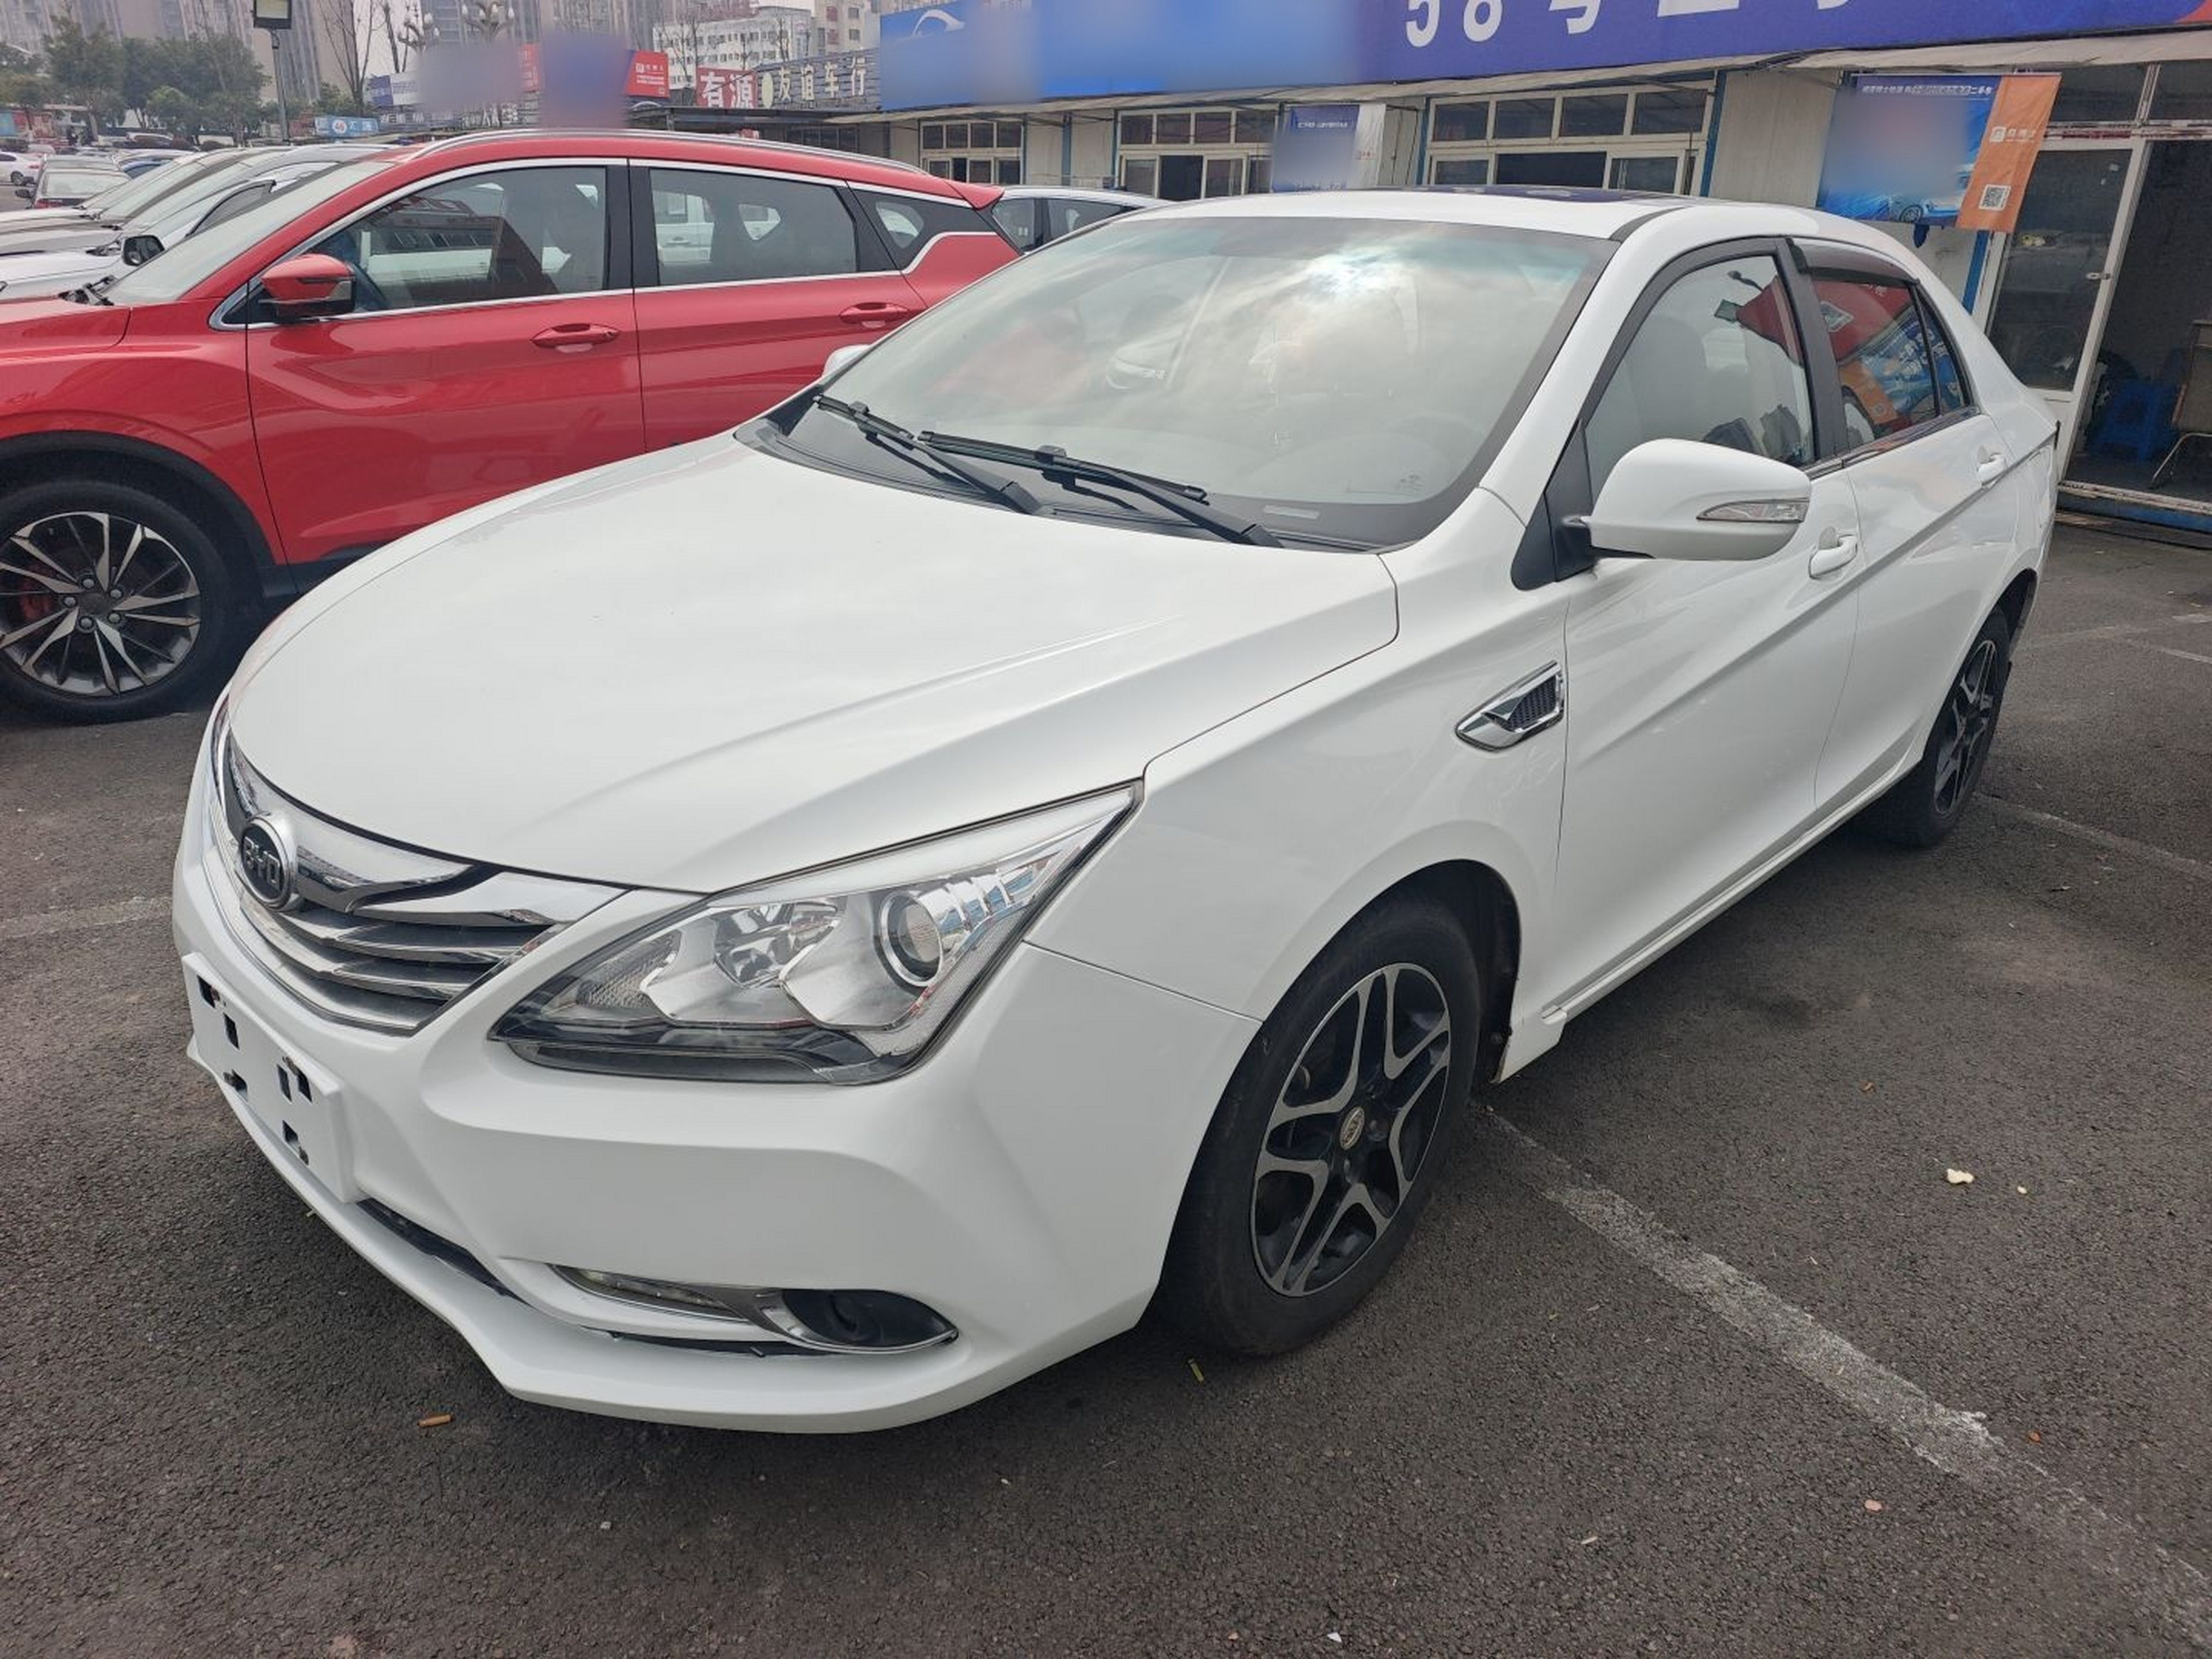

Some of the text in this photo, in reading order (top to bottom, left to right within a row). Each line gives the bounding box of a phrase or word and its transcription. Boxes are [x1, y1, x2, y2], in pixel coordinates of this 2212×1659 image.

[700, 71, 753, 108] 有源
[779, 56, 867, 102] 友谊车行
[244, 836, 281, 888] BYD
